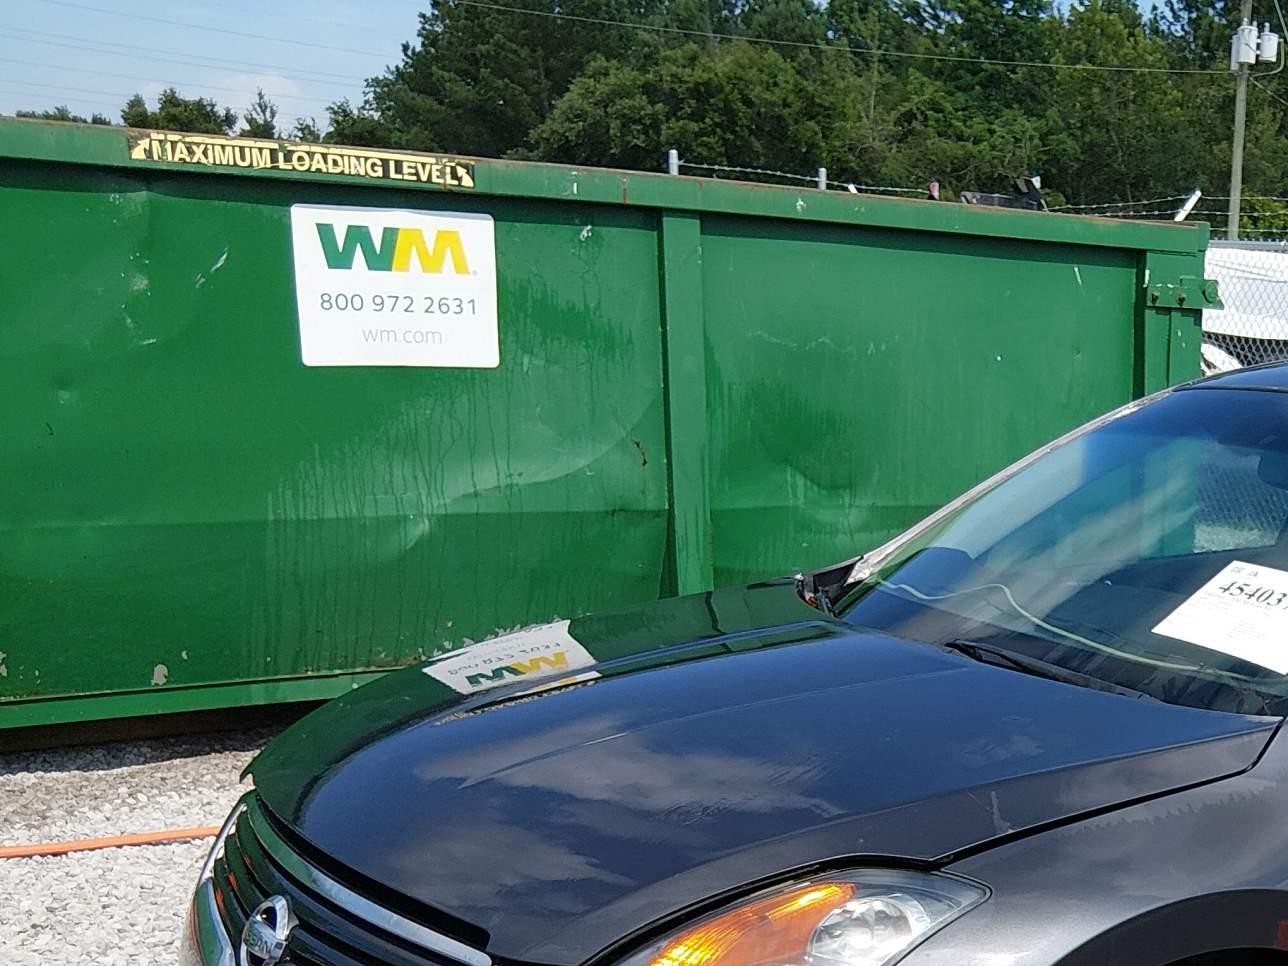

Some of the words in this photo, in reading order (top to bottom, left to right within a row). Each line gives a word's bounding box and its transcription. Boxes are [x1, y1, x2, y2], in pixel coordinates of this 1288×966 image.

[152, 138, 272, 168] MAXIMUM
[278, 150, 383, 177] LOADING
[389, 161, 459, 186] LEVEL
[315, 222, 470, 275] WM
[320, 293, 364, 312] 800
[372, 294, 415, 313] 972
[423, 295, 477, 316] 2631
[362, 327, 443, 345] wm.com
